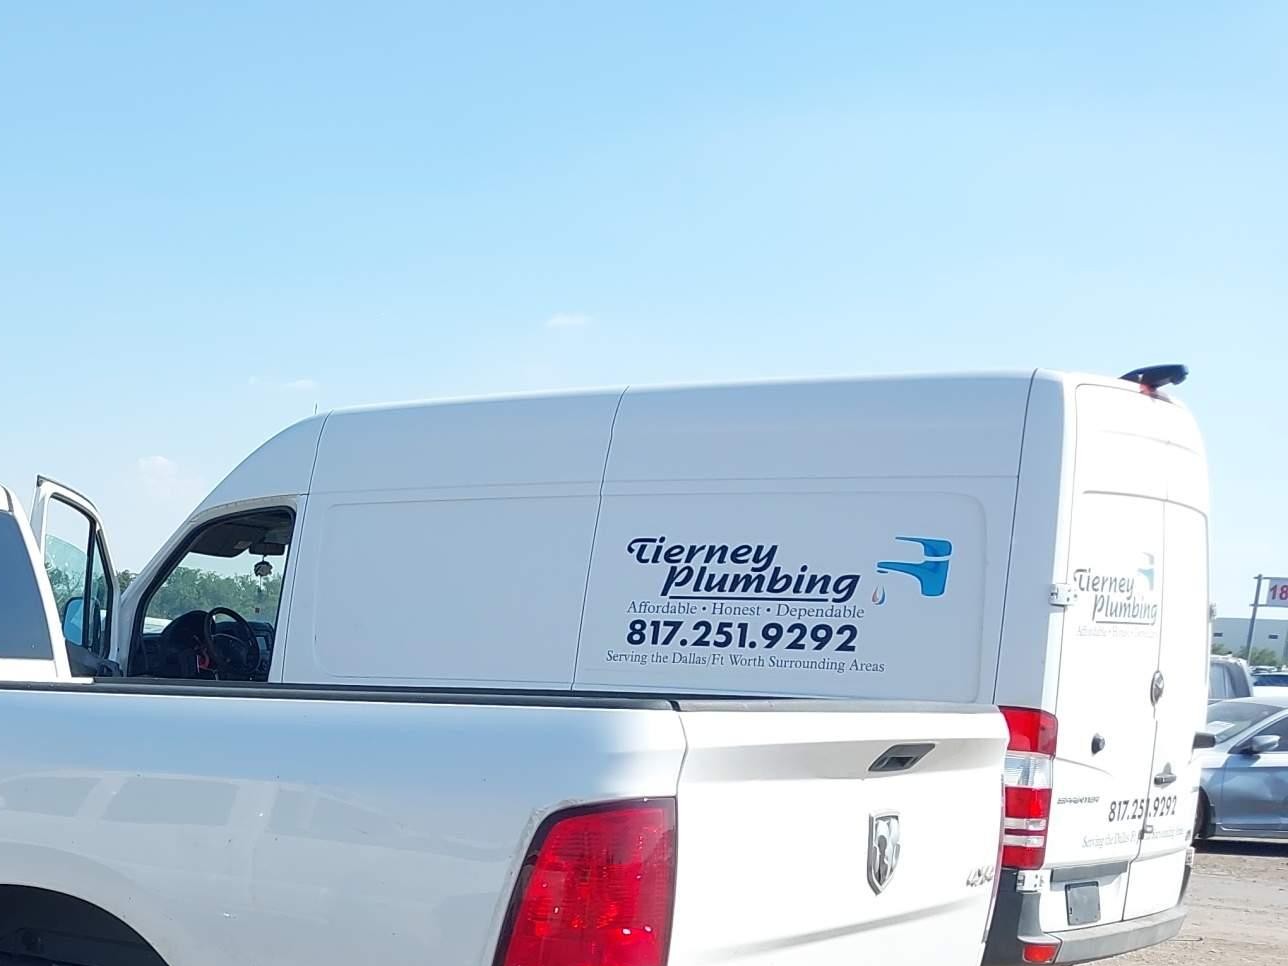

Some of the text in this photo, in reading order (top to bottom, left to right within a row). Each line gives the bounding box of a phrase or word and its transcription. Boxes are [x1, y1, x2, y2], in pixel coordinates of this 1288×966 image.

[626, 536, 778, 572] Tierney
[661, 565, 861, 604] Plumbing
[1073, 567, 1135, 601] Tierney
[626, 601, 865, 621] Affordable Honest Dependable
[1092, 594, 1158, 627] Plumbing
[626, 619, 859, 653] 817.251.9292
[605, 650, 649, 667] Serving
[650, 652, 670, 665] the
[728, 653, 765, 668] Worth
[768, 655, 846, 674] Surrounding
[849, 660, 886, 673] Areas
[1108, 795, 1178, 822] 817.251.9292
